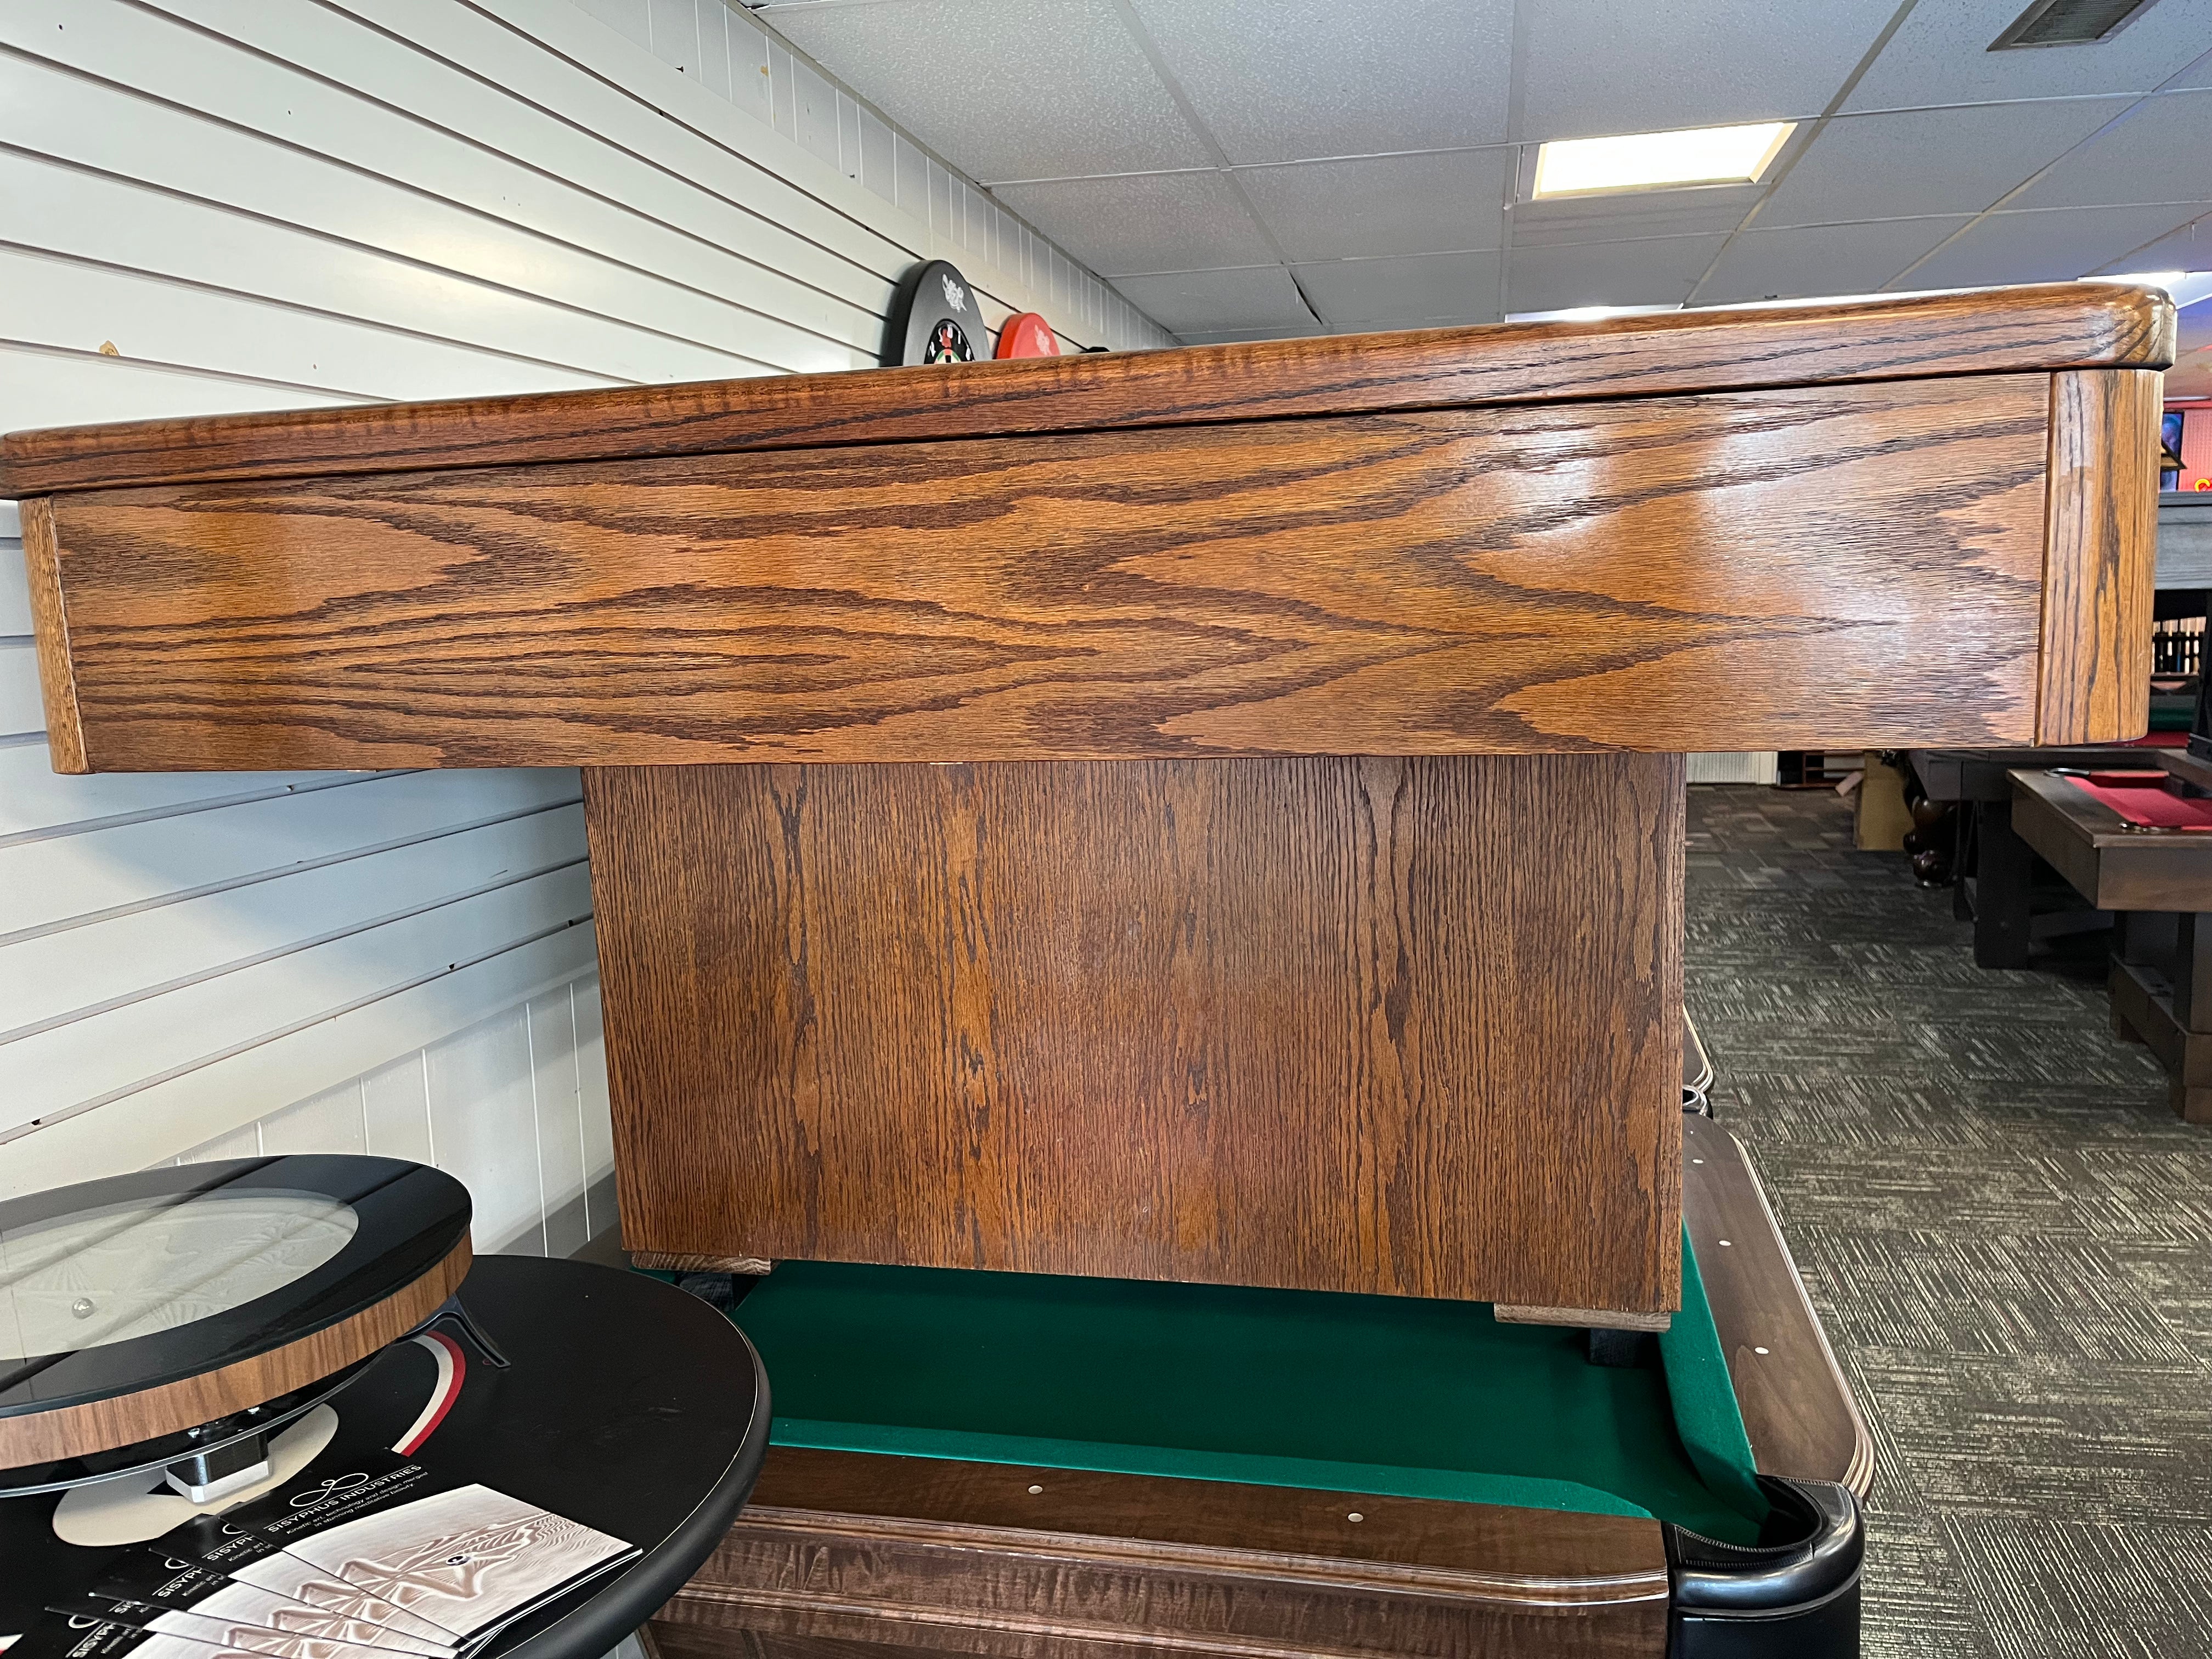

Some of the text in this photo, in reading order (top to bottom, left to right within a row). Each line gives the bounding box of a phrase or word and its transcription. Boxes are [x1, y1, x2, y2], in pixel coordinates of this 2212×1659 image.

[268, 1465, 421, 1532] SISYPHUS INDUSTRIES
[286, 1521, 311, 1534] Kinetic
[325, 1499, 364, 1517] technology
[365, 1492, 379, 1500] and
[379, 1482, 402, 1494] design
[403, 1471, 428, 1484] merged
[323, 1509, 354, 1523] stunning
[354, 1493, 390, 1510] meditative
[207, 1536, 253, 1561] SISYPH
